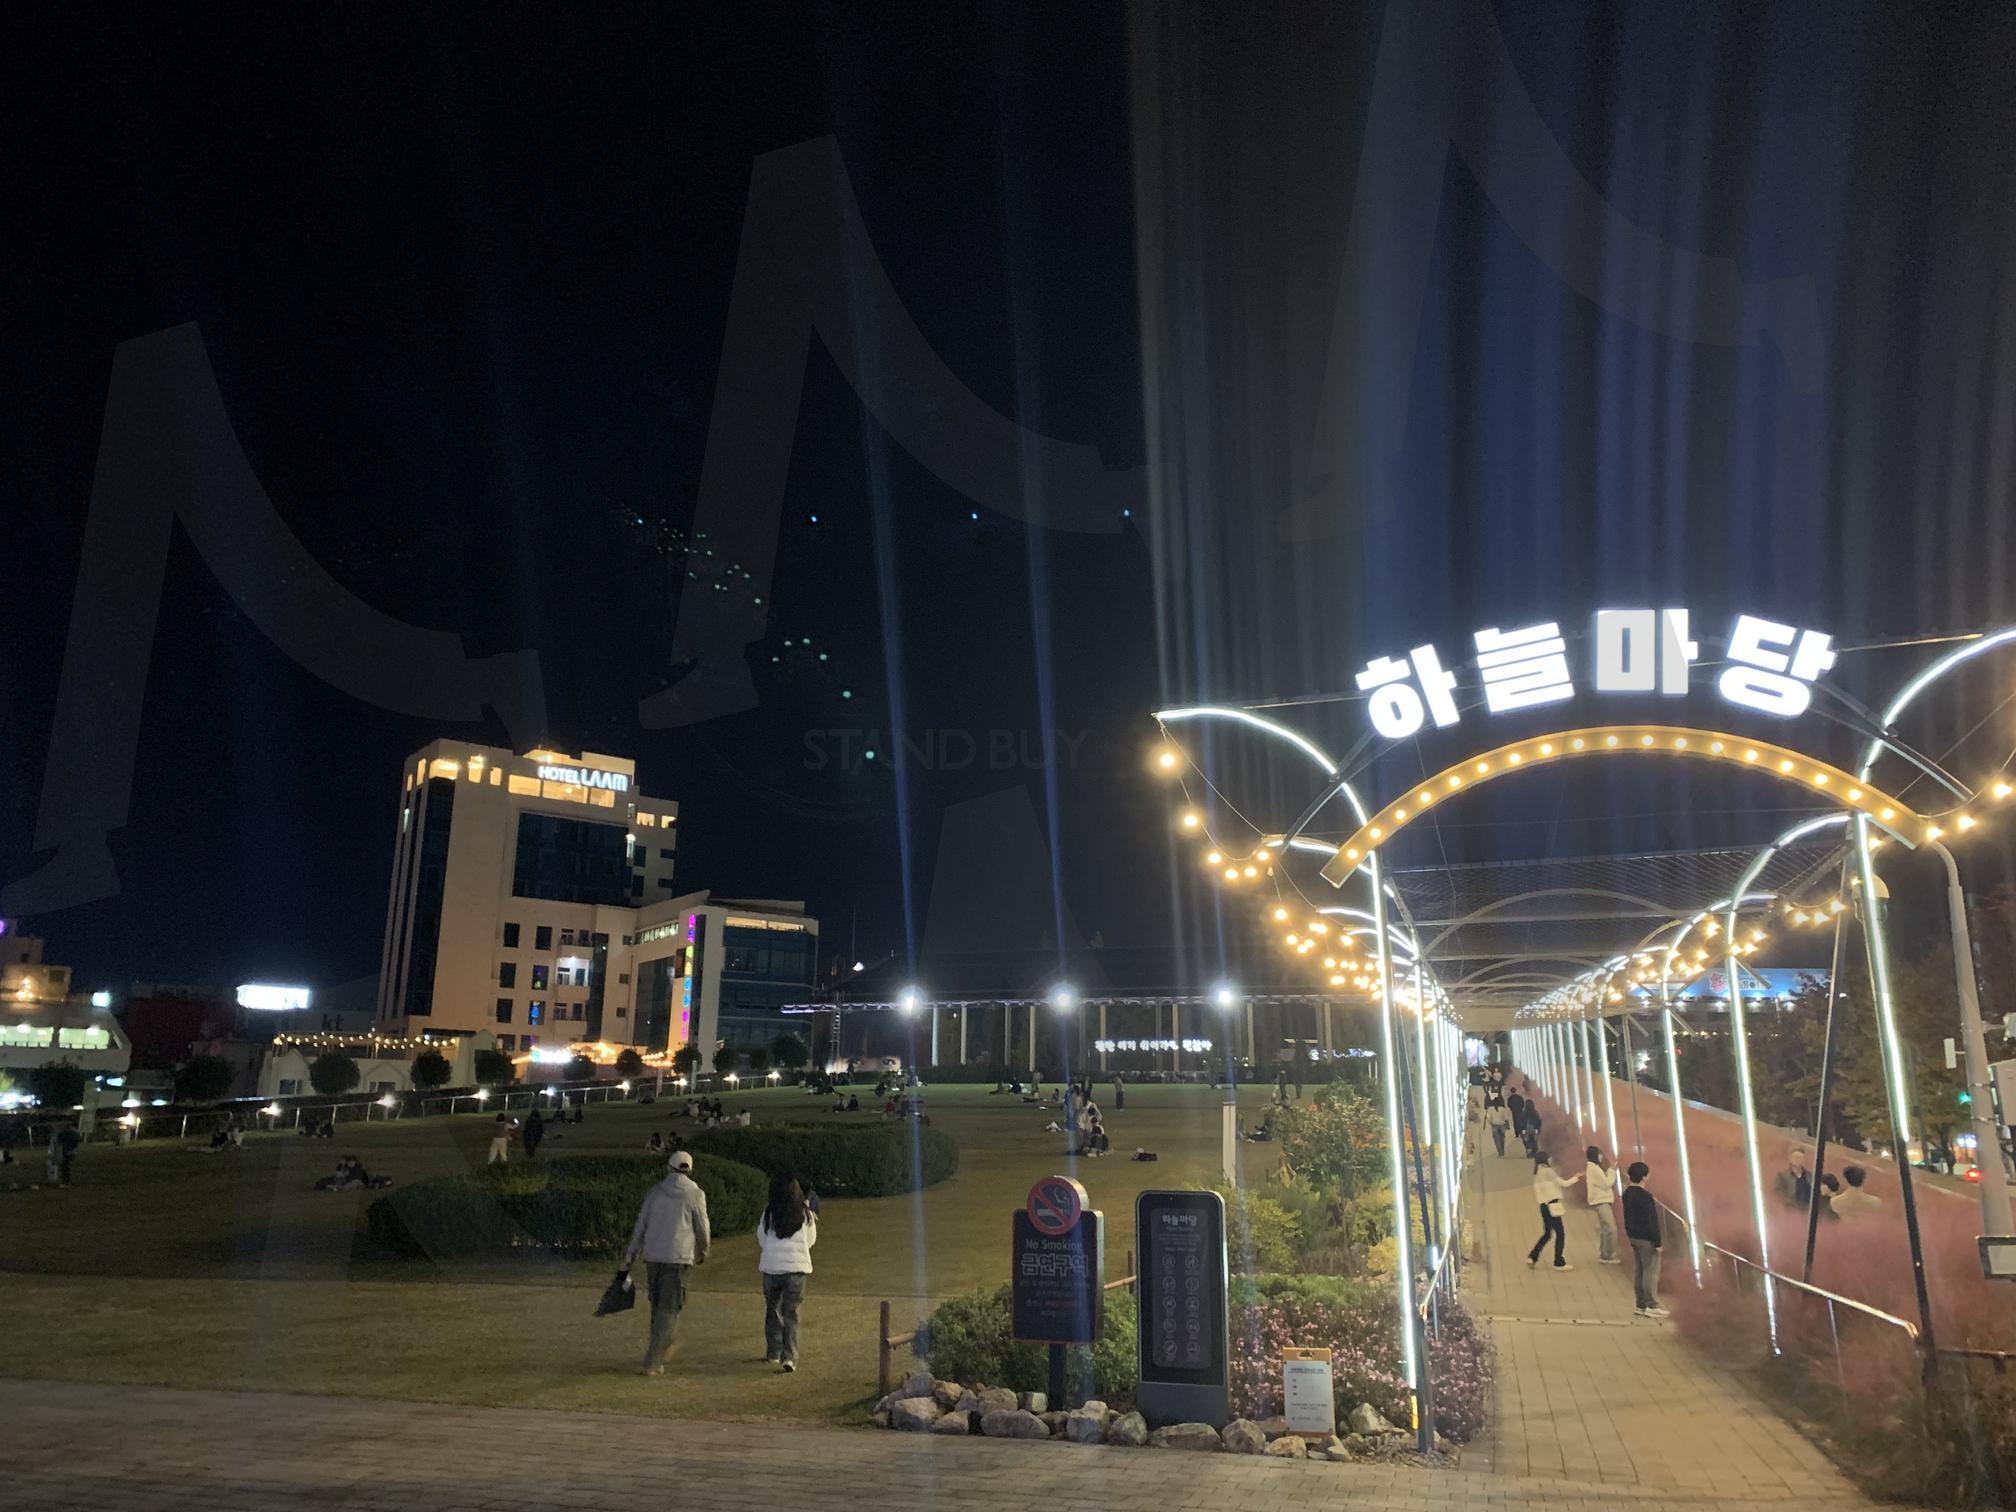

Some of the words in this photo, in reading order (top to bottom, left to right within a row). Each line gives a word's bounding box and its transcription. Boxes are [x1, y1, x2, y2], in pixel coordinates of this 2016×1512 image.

[1355, 608, 1838, 740] 하늘마당
[538, 765, 581, 785] HOTEL
[1162, 1215, 1197, 1226] 하늘마당
[1025, 1239, 1039, 1249] No
[1021, 1253, 1089, 1277] 금연구역
